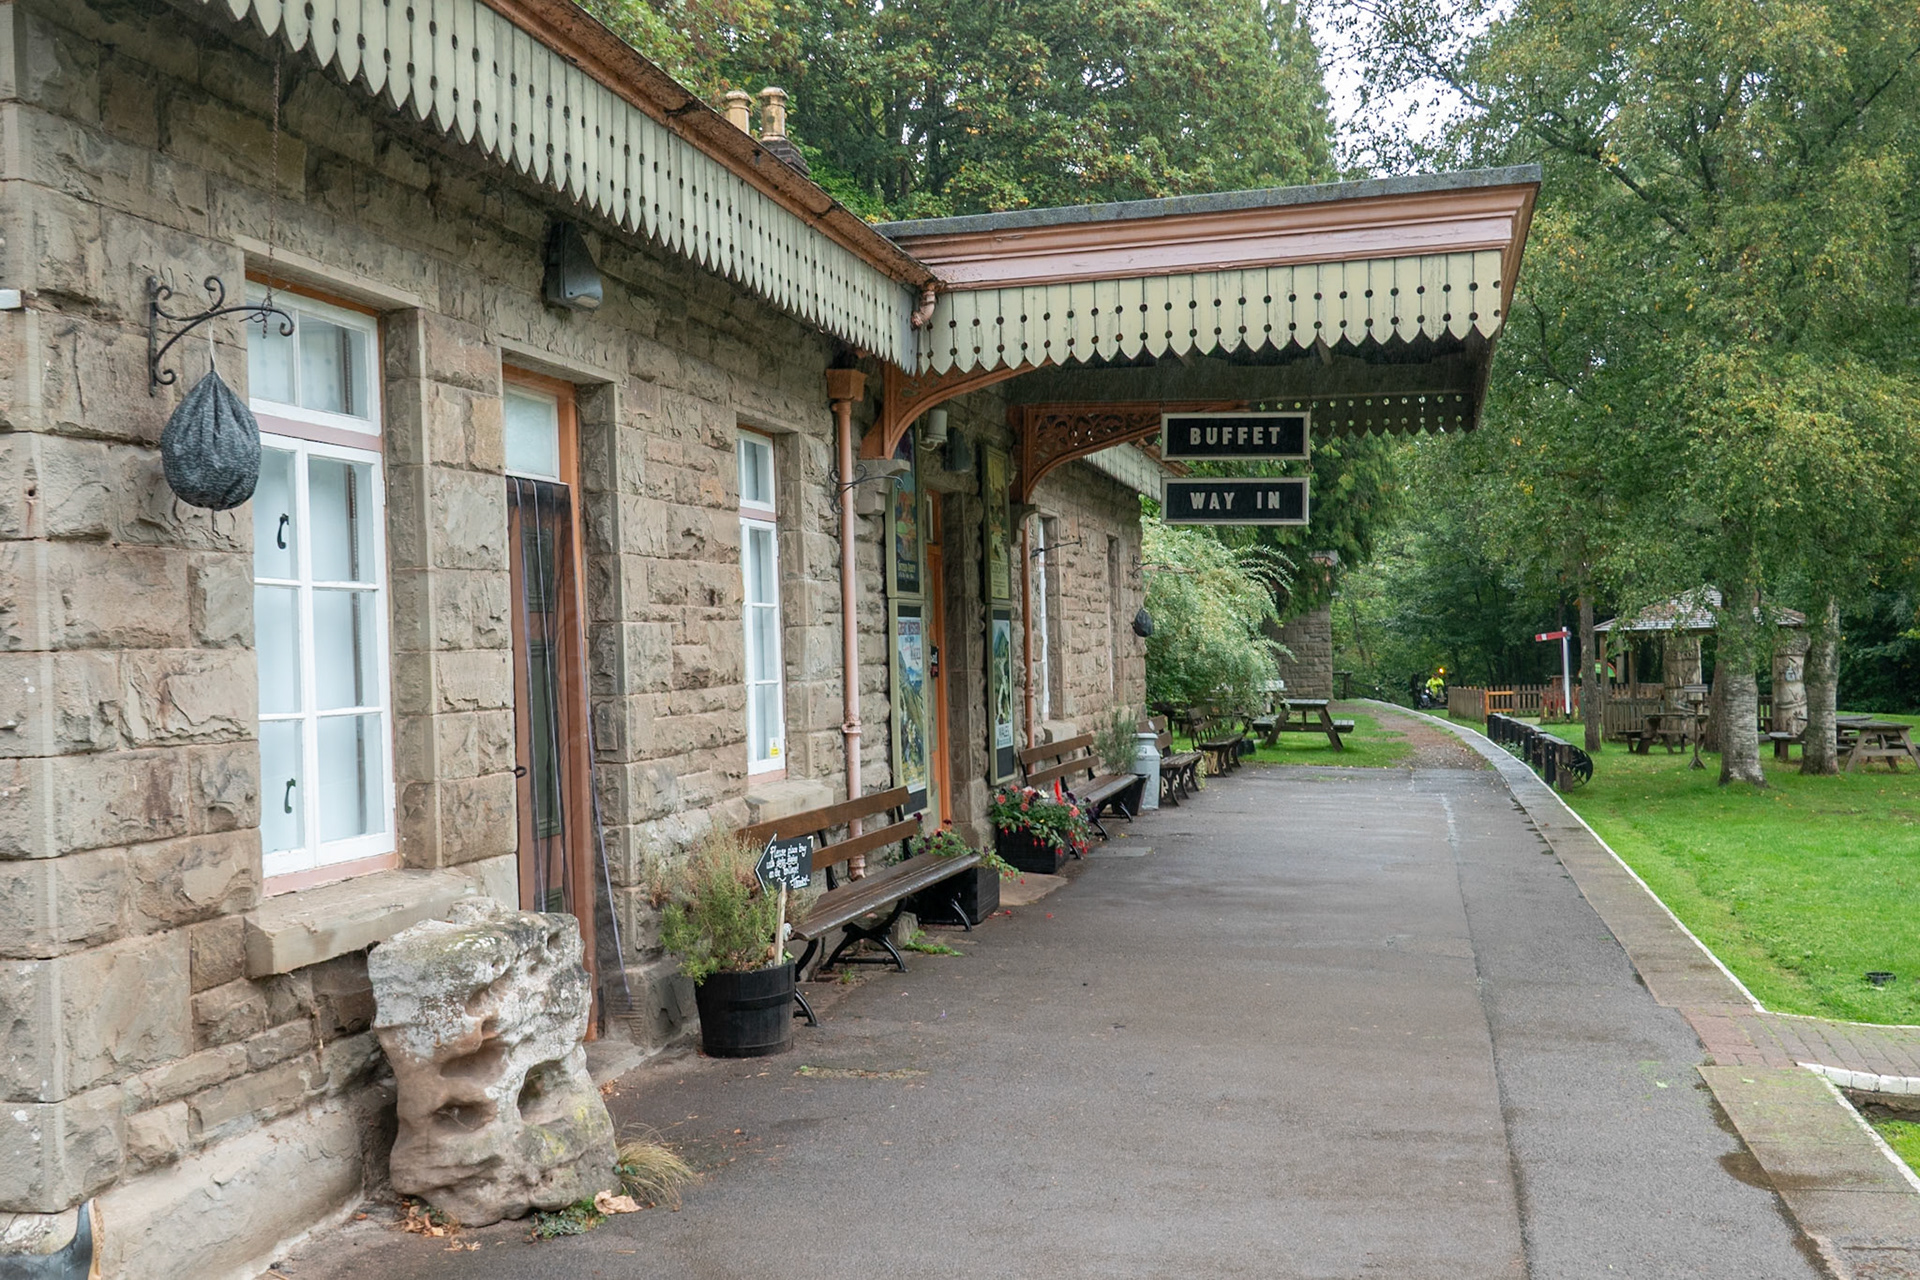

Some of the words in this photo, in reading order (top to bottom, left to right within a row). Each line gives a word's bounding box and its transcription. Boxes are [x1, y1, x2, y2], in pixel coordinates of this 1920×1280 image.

[1189, 426, 1281, 446] BUFFET
[1189, 491, 1236, 511] WAY
[1256, 490, 1281, 510] IN
